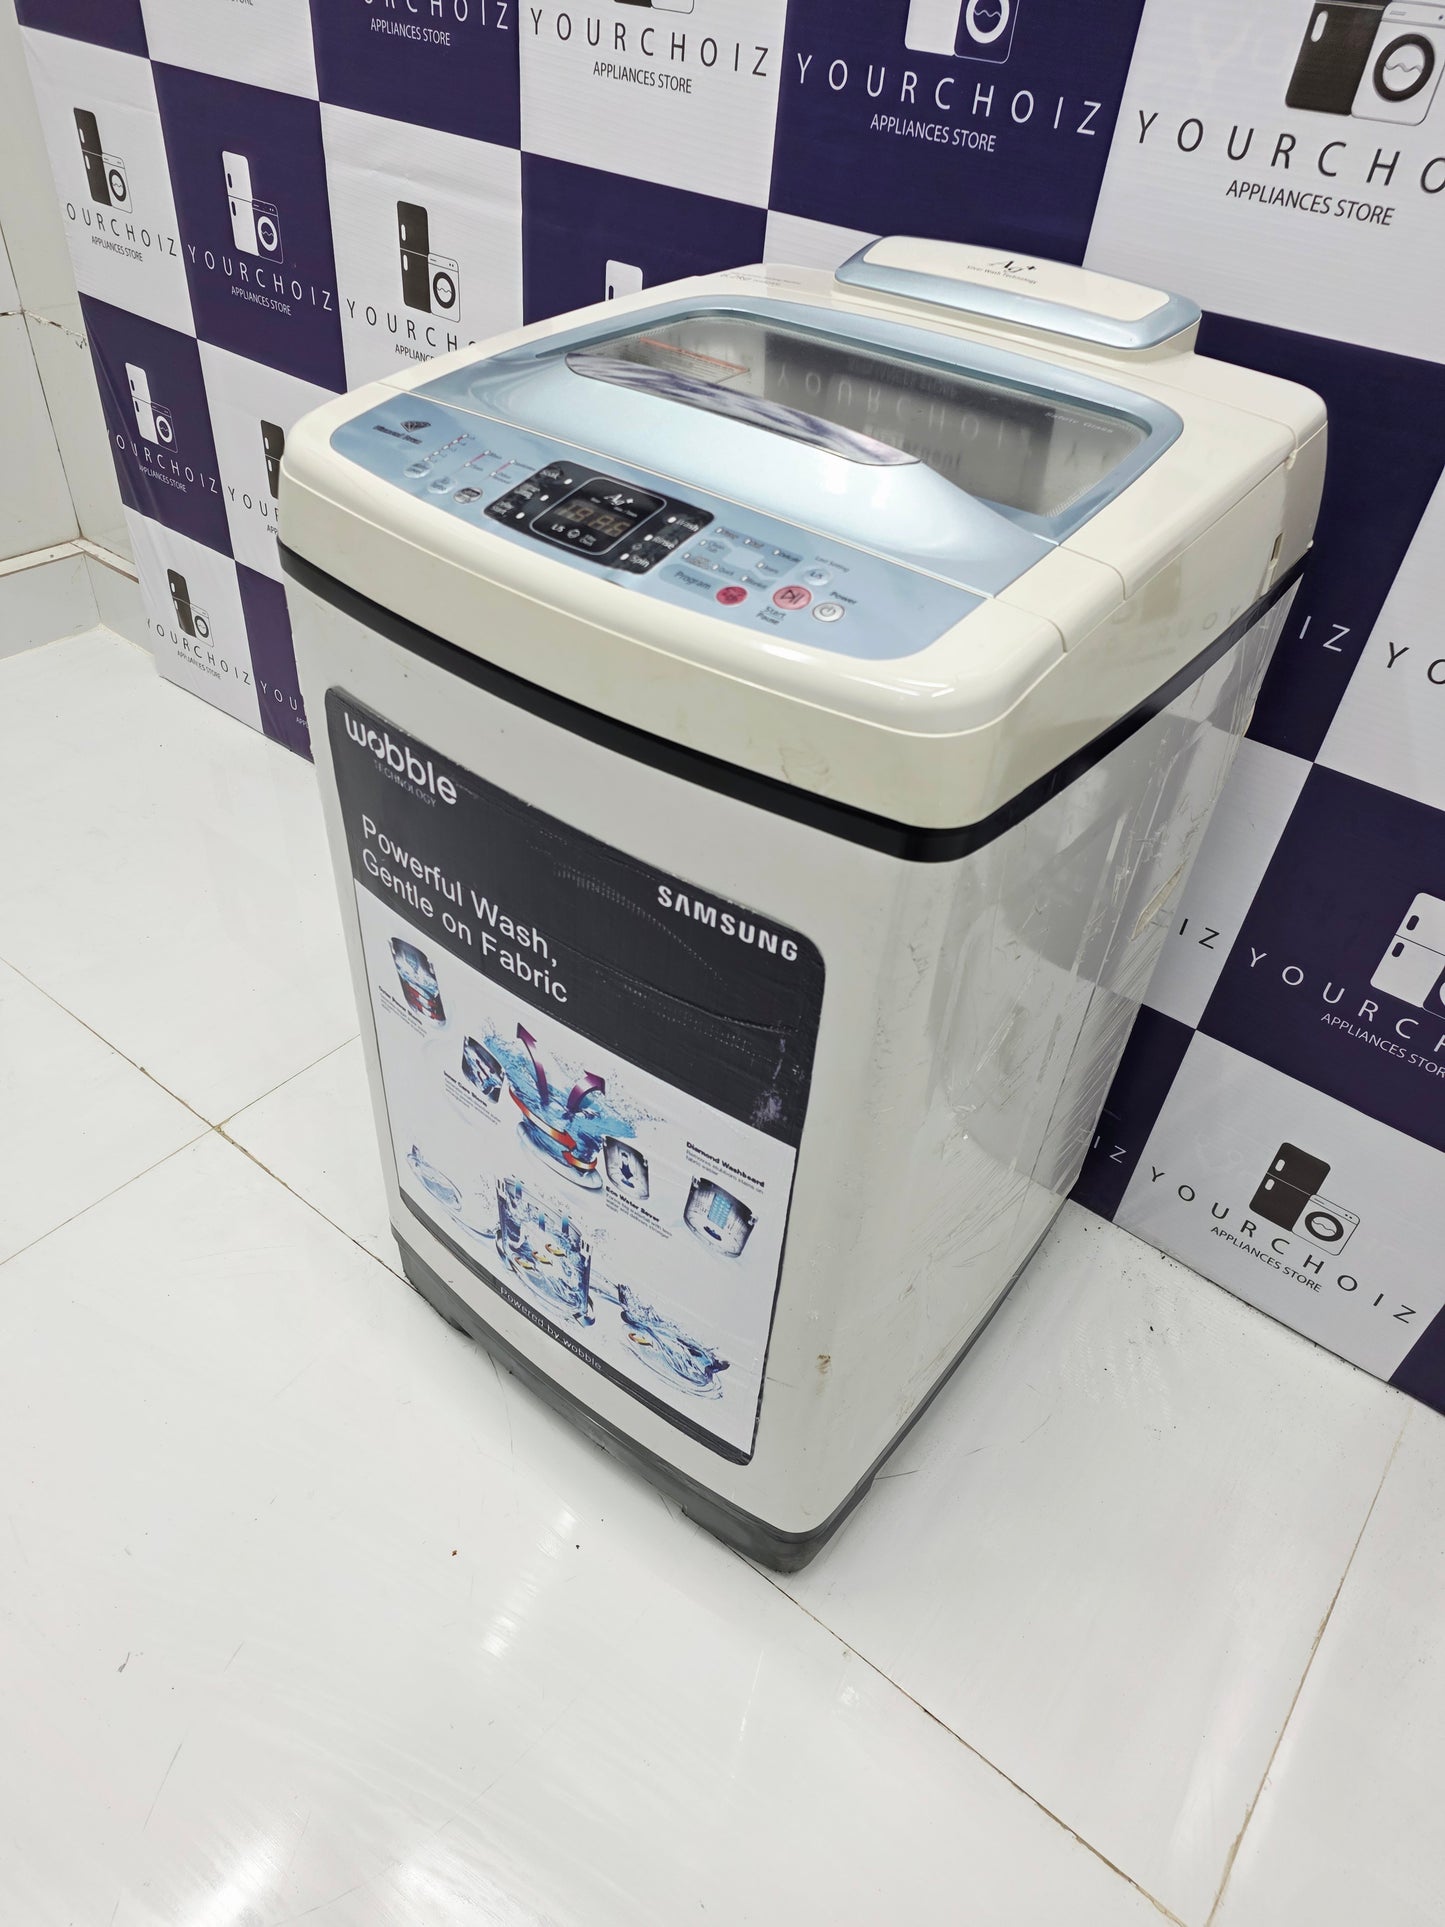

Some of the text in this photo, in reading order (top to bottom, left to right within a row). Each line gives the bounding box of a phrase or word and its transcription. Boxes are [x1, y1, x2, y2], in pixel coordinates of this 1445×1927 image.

[370, 18, 451, 46] APPLIANCES STORE
[530, 8, 769, 77] YOURCHOIZ
[593, 61, 693, 94] APPLIANCES STORE
[797, 53, 1102, 136] YOURCHOIZ
[870, 114, 997, 153] APPLIANCES STORE
[1226, 180, 1396, 227] APPLIANCES STORE
[91, 235, 143, 262] APPLIANCES STORE
[187, 244, 333, 312] YOURCHOIZ
[231, 285, 292, 316] APPLIANCES STORE
[169, 478, 188, 494] STORE
[630, 554, 650, 568] Spin
[653, 536, 676, 550] Rinse
[673, 571, 712, 590] Program
[829, 591, 857, 605] Power
[756, 612, 781, 626] Pause
[764, 606, 787, 619] Start
[344, 711, 458, 805] wobble
[374, 759, 437, 808] TECHNOLOGY
[361, 814, 559, 967] Powerful Wash,
[362, 847, 569, 1004] Gentle on Fabric
[657, 884, 799, 962] SAMSUNG
[1321, 1012, 1408, 1059] APPLIANCES
[686, 1140, 721, 1165] Diamond
[721, 1159, 765, 1188] Washboard
[619, 1194, 639, 1210] Water
[1150, 1166, 1417, 1324] YOURCHOIZ
[1210, 1225, 1323, 1293] APPLIANCES STORE
[547, 1325, 560, 1340] by
[562, 1337, 602, 1371] wobble
